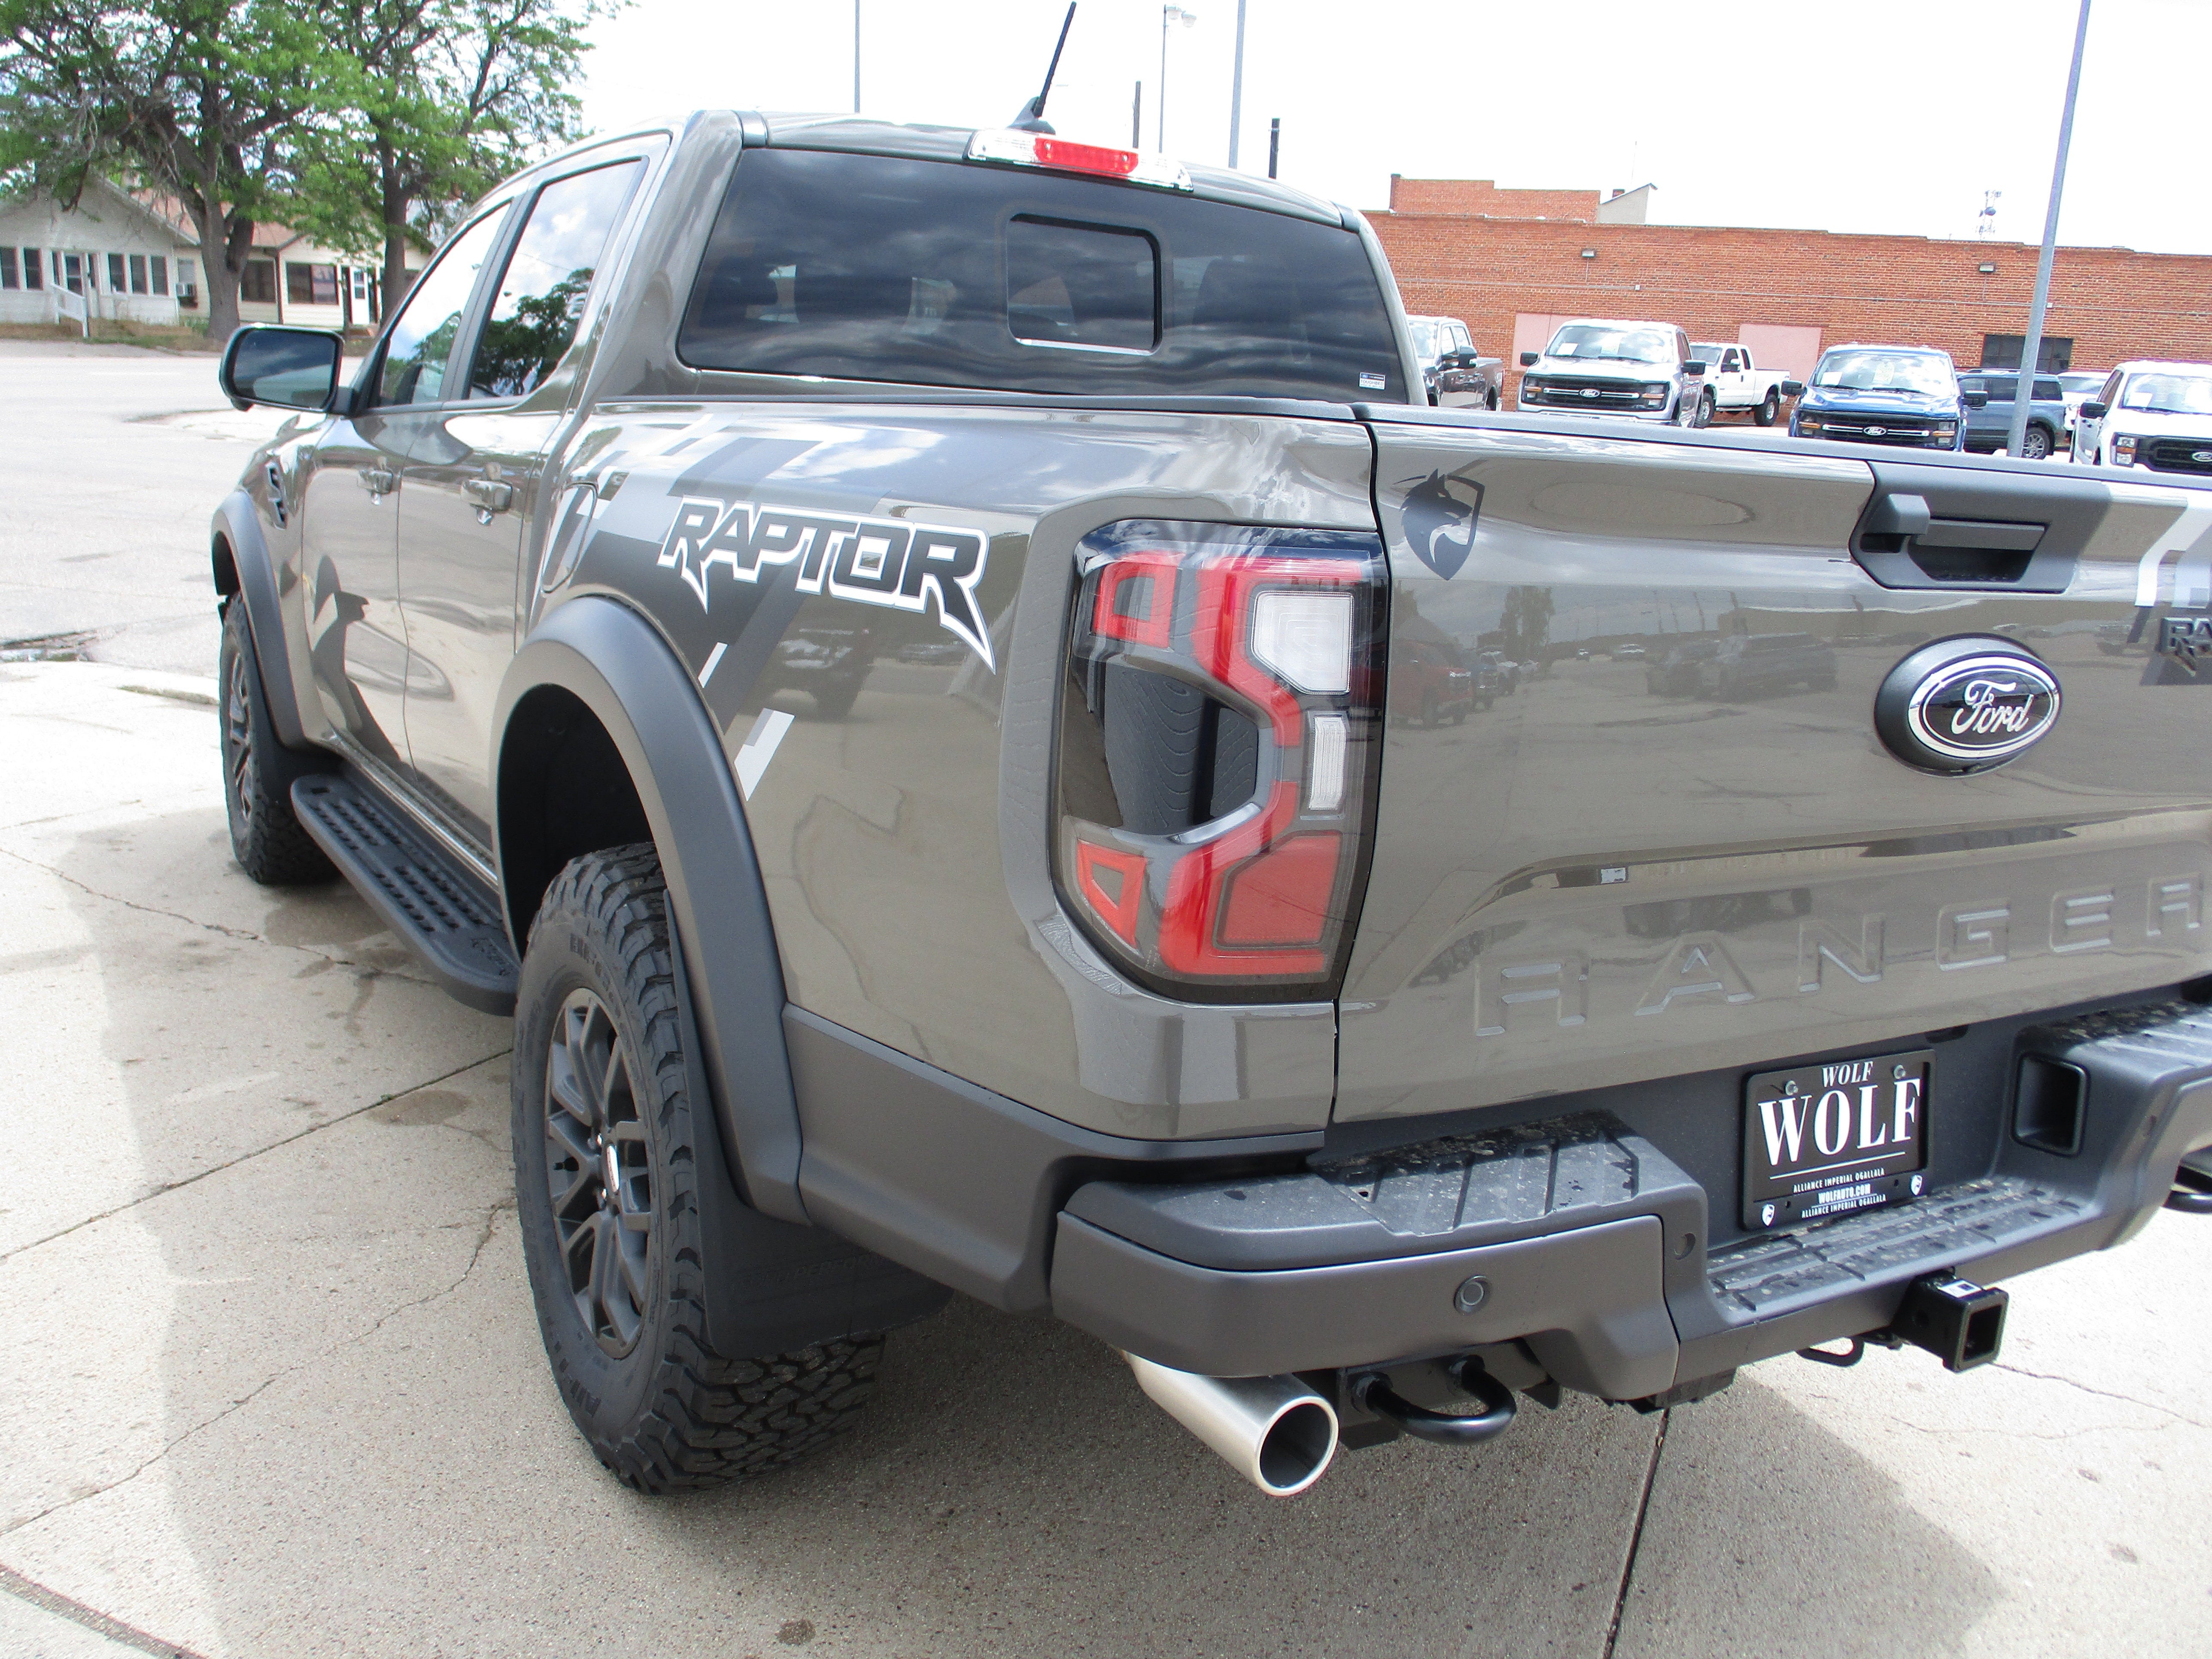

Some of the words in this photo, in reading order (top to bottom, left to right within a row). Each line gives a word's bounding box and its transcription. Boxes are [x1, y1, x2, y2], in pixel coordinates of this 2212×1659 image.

[657, 495, 996, 675] RAPTOR
[1951, 679, 2034, 735] Ford
[1474, 872, 2204, 1037] RANGER
[1822, 1061, 1874, 1088] WOLF
[1758, 1078, 1920, 1166] WOLF
[1793, 1180, 1823, 1193] ALLIANCE
[1825, 1174, 1853, 1187] IMPERIAL
[1855, 1167, 1885, 1181] OGALLALA
[1818, 1183, 1871, 1204] WOLFAUTO.COM
[1802, 1206, 1829, 1219] ALLIANCE
[1831, 1200, 1857, 1212] IMPERIAL
[1859, 1194, 1886, 1207] OGALLALA
